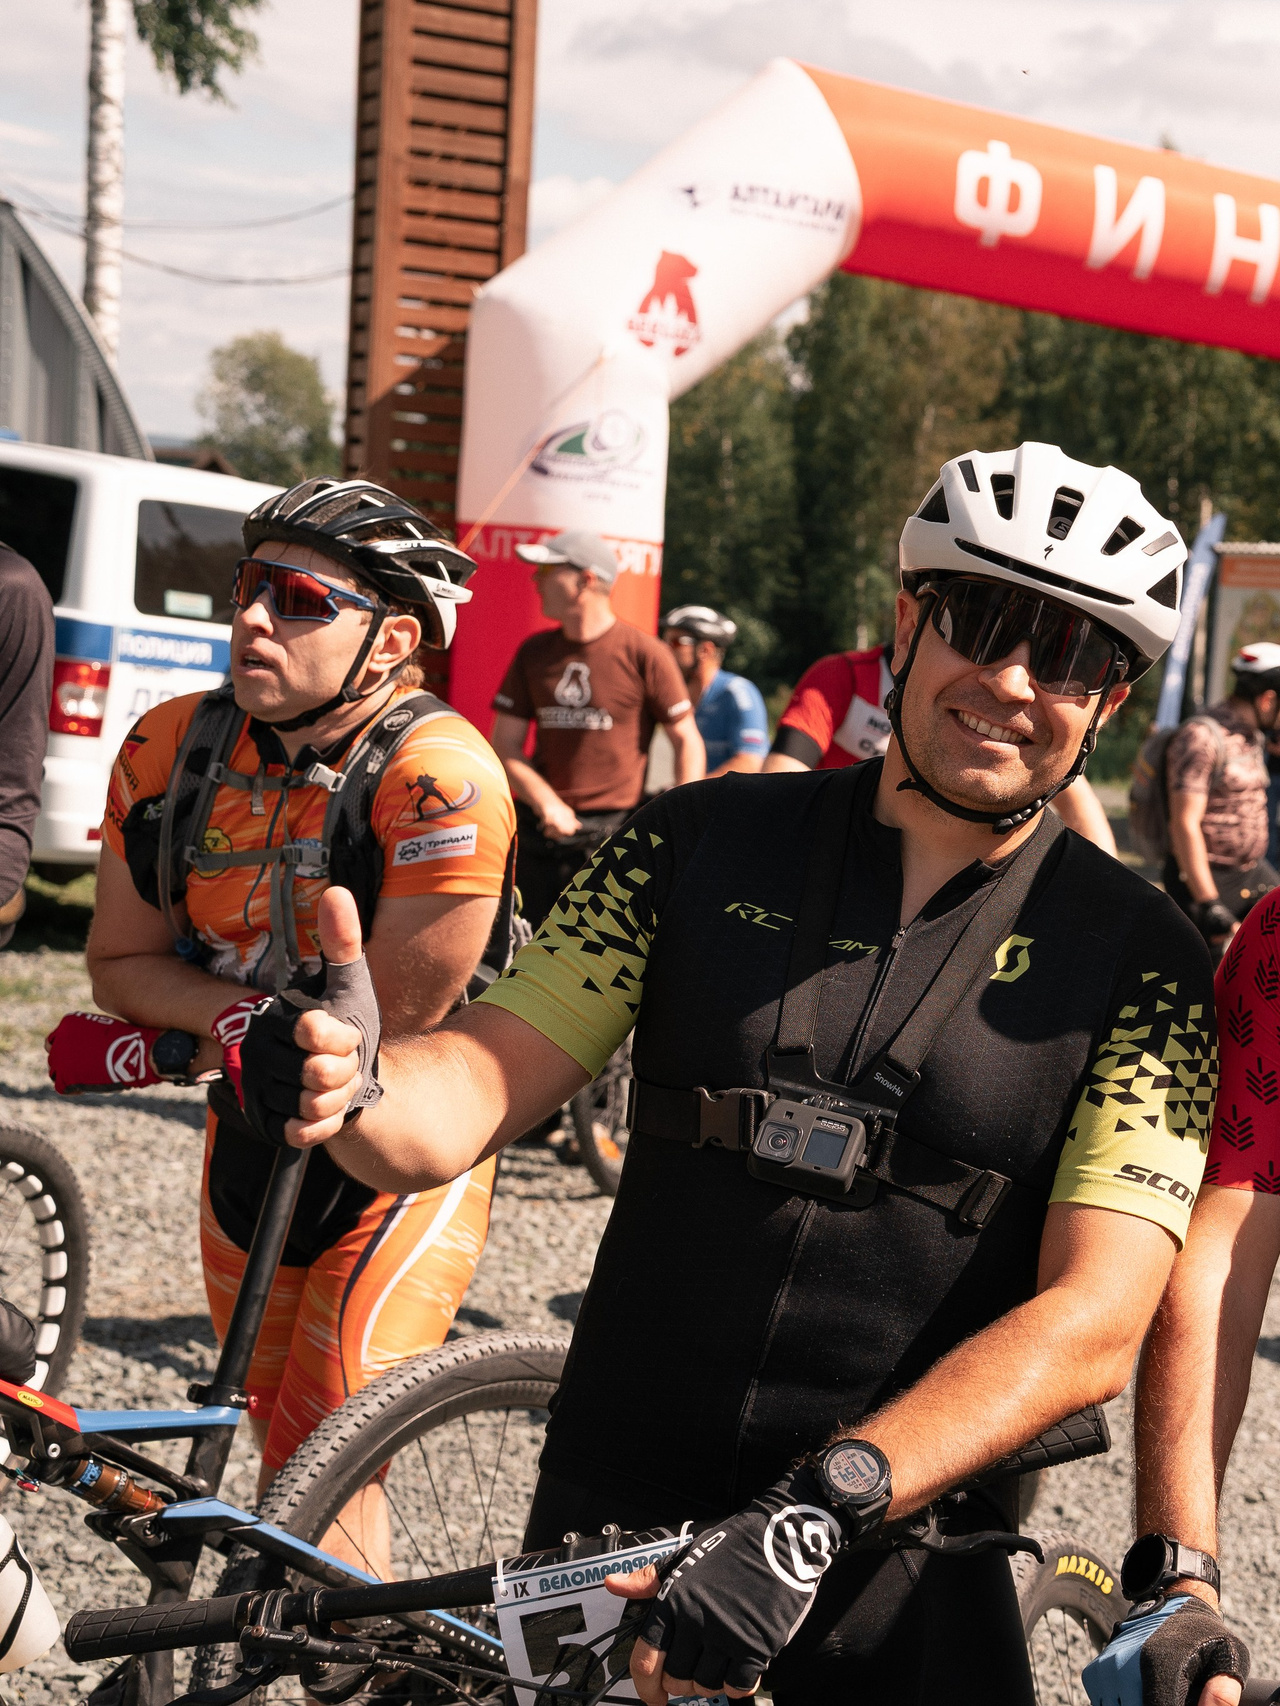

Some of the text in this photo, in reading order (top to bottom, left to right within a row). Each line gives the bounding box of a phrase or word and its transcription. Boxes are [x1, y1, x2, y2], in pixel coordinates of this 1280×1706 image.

[118, 633, 213, 667] ПОЛИЦИЯ
[873, 1071, 904, 1097] SnowHu
[513, 1581, 530, 1599] IX
[1055, 1555, 1115, 1595] MAXXIS
